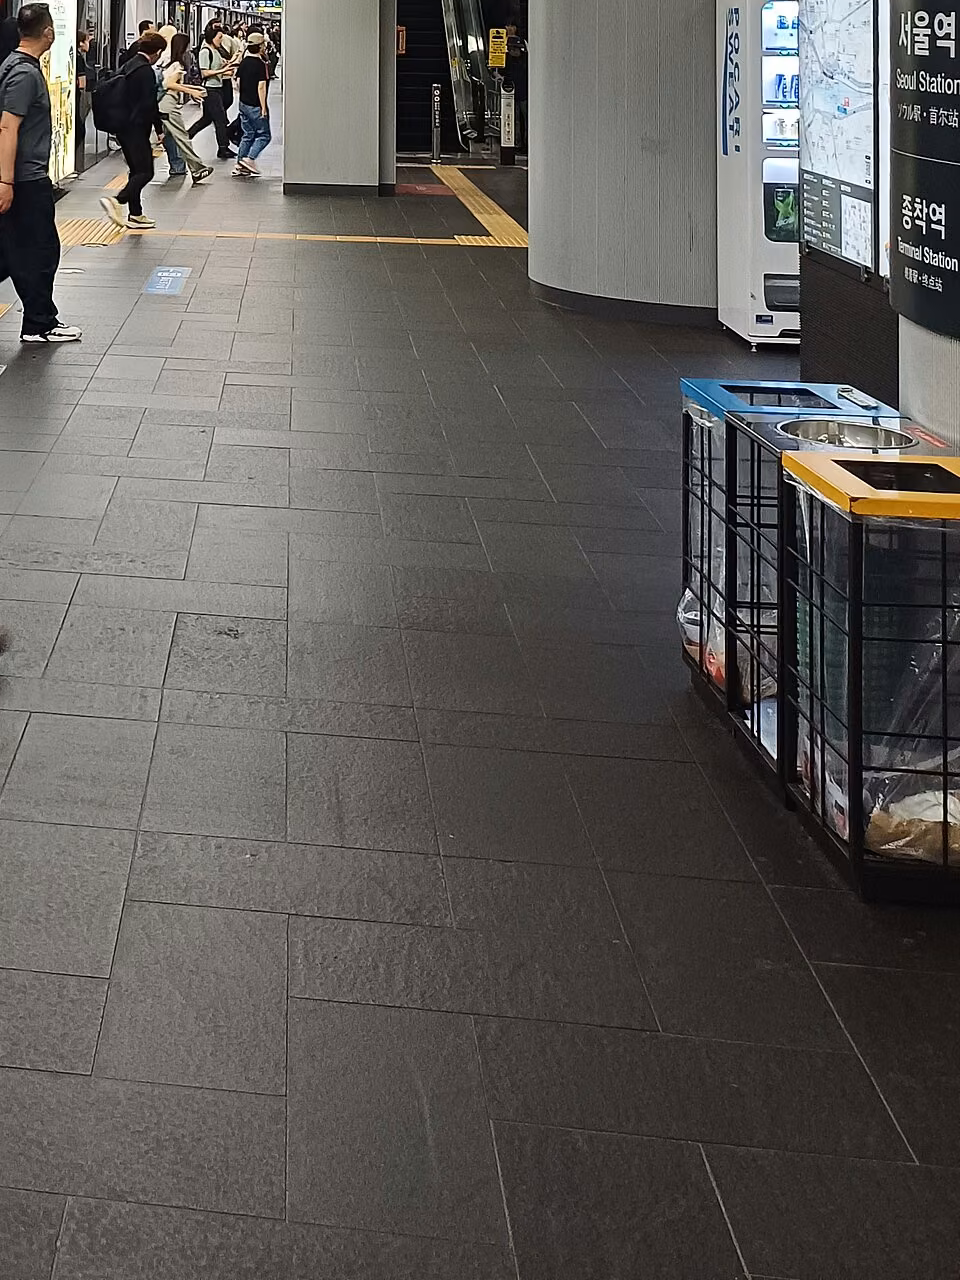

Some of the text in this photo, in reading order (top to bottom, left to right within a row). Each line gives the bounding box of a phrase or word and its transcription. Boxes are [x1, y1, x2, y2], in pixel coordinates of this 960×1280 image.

[898, 11, 956, 58] 서울역
[733, 8, 741, 152] POCARI
[896, 68, 960, 95] Seoul Station
[902, 194, 945, 240] 종착역
[897, 236, 959, 272] Terminal Station
